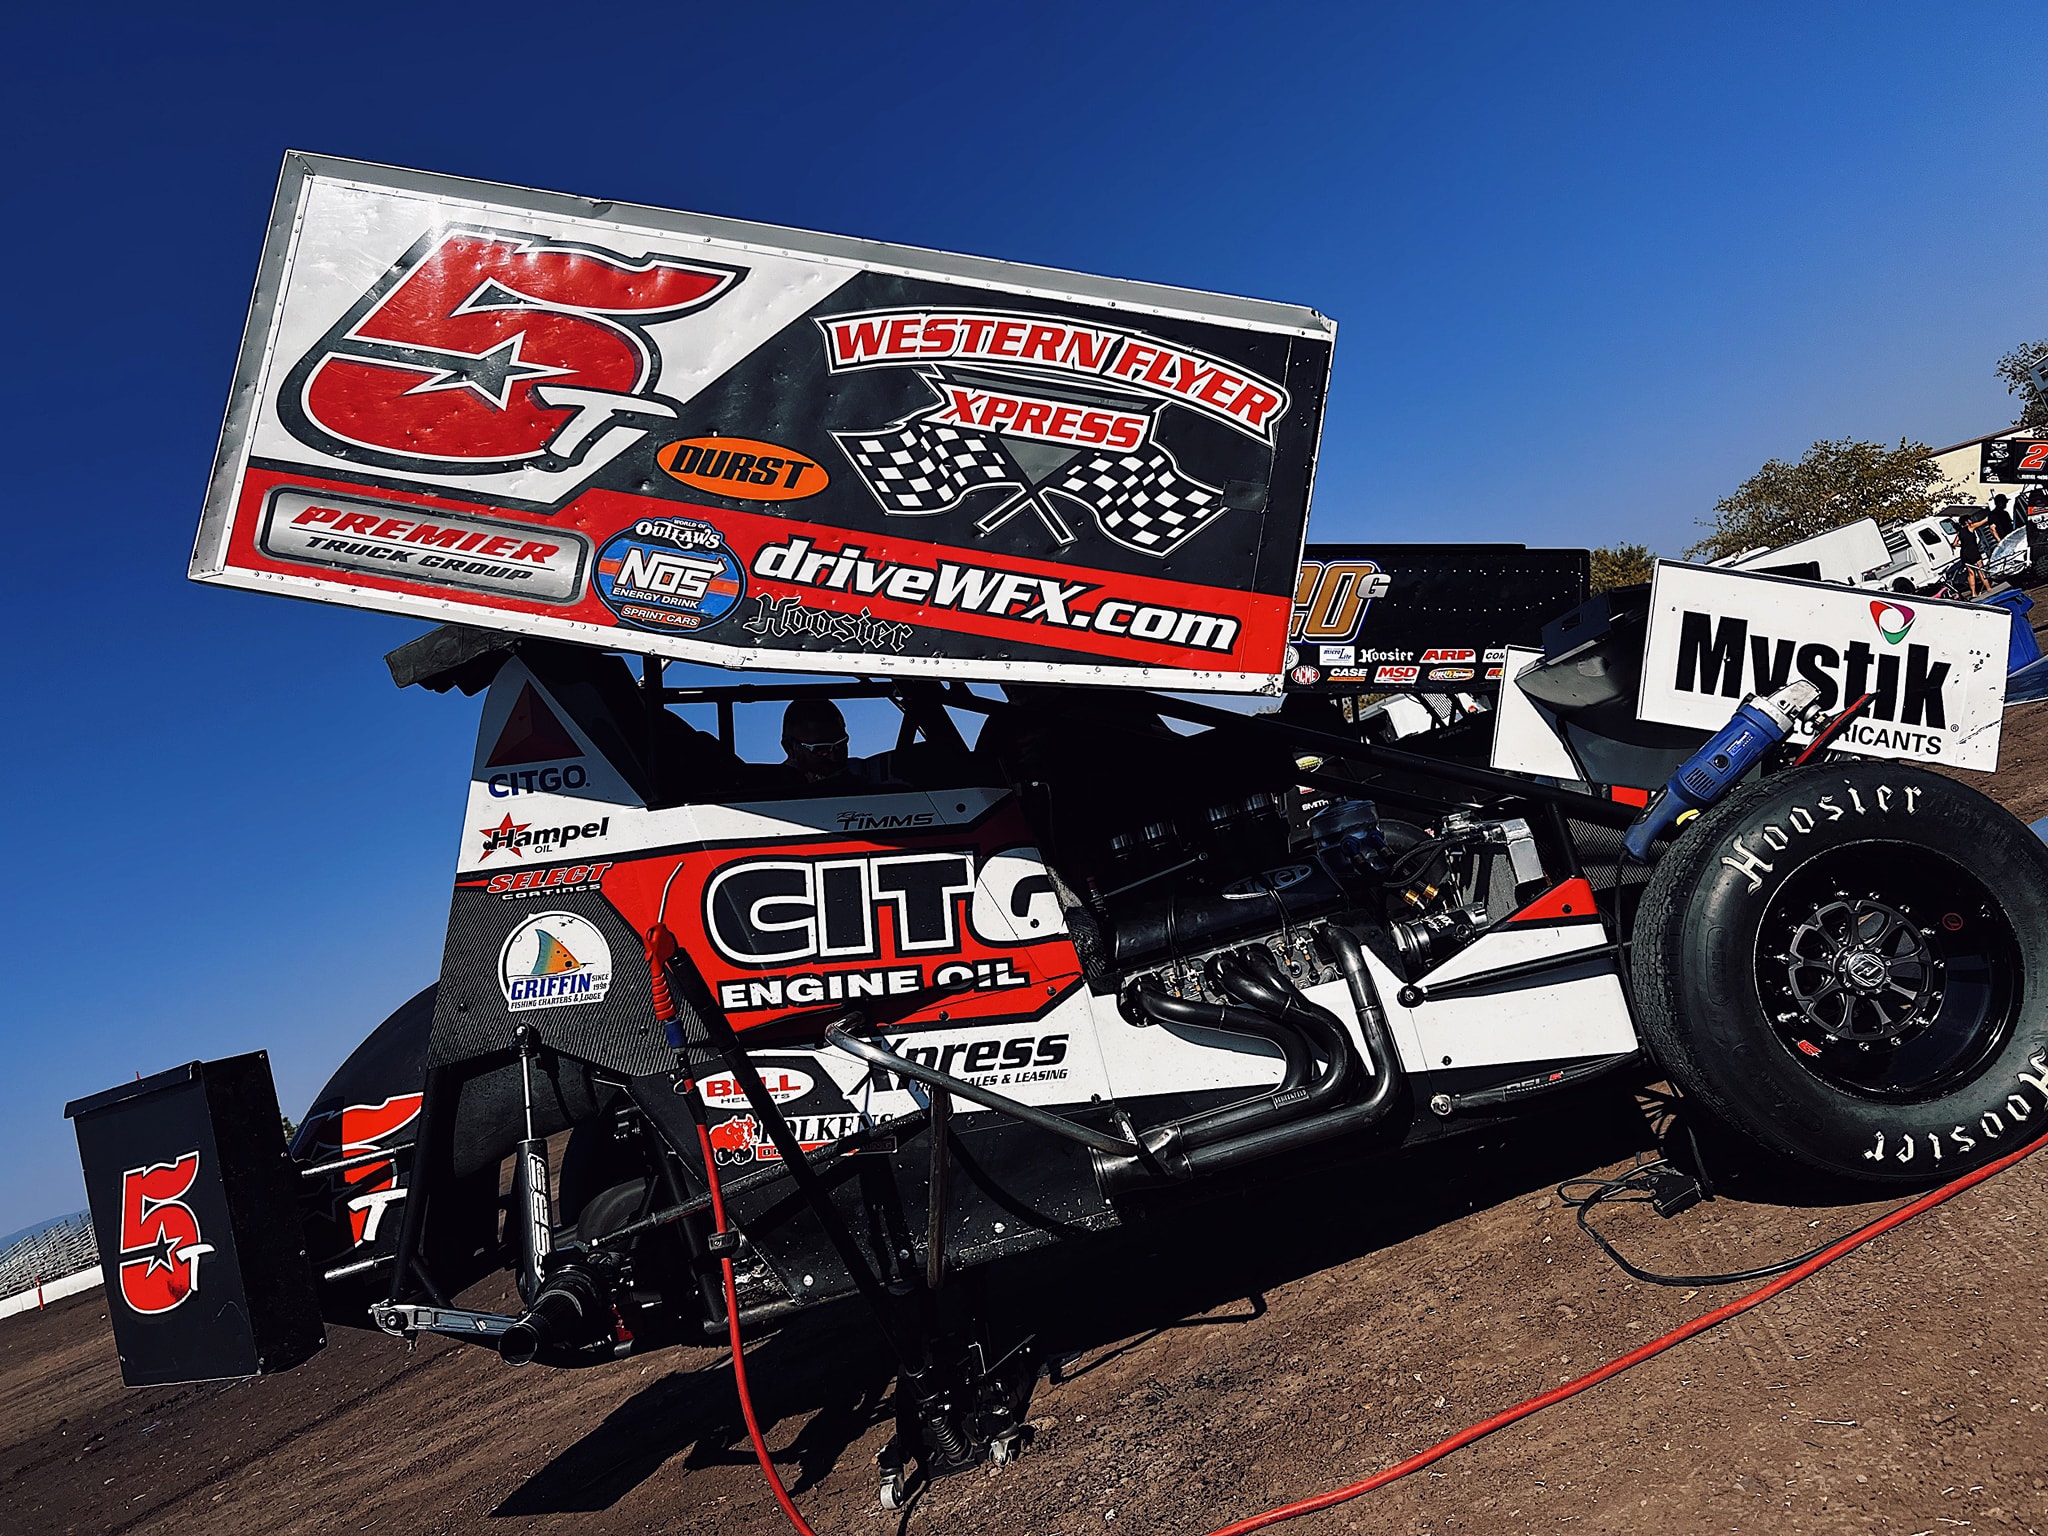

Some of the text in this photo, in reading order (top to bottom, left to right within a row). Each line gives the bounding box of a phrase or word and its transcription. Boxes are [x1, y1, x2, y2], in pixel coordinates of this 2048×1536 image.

[833, 316, 1283, 428] WESTERN FLYER
[941, 386, 1150, 450] XPRESS
[666, 444, 814, 490] DURST
[291, 506, 560, 564] PREMIER
[305, 536, 533, 580] TRUCK GROUP
[615, 548, 728, 599] NOS
[612, 587, 700, 609] ENERGY DRINK
[754, 539, 1241, 652] driveWFX.com
[622, 607, 699, 627] SPRINT CARS
[742, 592, 914, 652] Hoosier
[1358, 648, 1414, 663] Hoosier
[1422, 650, 1475, 660] ARP
[1293, 666, 1318, 684] ACME
[1330, 668, 1368, 677] CASE
[1377, 666, 1418, 677] MSD
[488, 765, 588, 798] CITGO
[484, 816, 610, 850] Hampel
[837, 813, 935, 831] TIMMS
[534, 844, 553, 854] OIL
[1719, 778, 1923, 896] Hoosier
[487, 862, 613, 893] SELECT
[502, 883, 601, 900] COATINGS
[511, 973, 593, 1000] GRIFFIN
[591, 973, 609, 982] SINCE
[722, 962, 1025, 1009] ENGINE OIL
[511, 1000, 537, 1010] FISHING
[1001, 1073, 1011, 1084] &
[1014, 1068, 1069, 1083] LEASING
